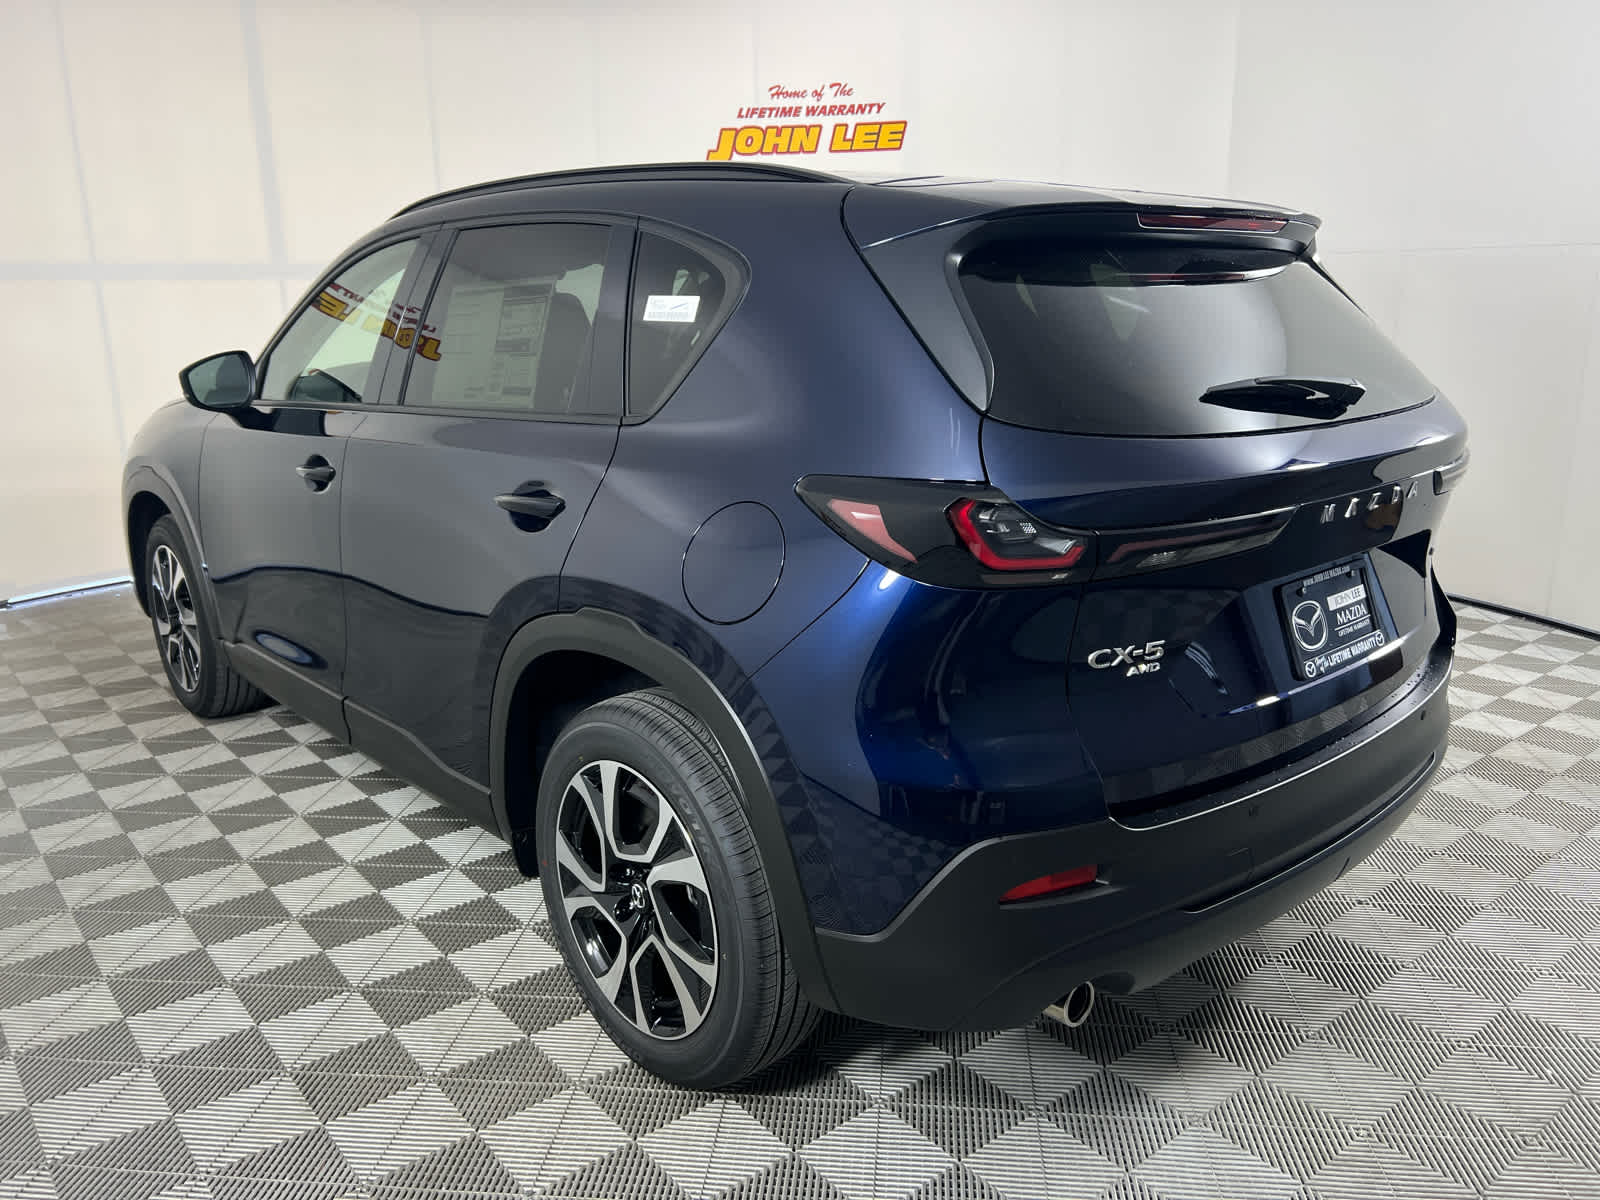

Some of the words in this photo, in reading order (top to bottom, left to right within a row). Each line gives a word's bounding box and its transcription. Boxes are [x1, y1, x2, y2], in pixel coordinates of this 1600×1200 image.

[768, 84, 808, 100] Home
[811, 84, 825, 101] of
[829, 82, 854, 98] The
[737, 105, 802, 119] LIFETIME
[805, 102, 886, 117] WARRANTY
[706, 124, 823, 161] JOHN
[829, 120, 907, 153] LEE
[1320, 480, 1418, 524] MAZDA
[1351, 587, 1363, 600] LEE
[1336, 602, 1368, 625] MAZDA
[1088, 640, 1165, 669] CX-5
[1328, 648, 1352, 667] LIFETIME
[1350, 636, 1376, 657] WARRANTY
[1126, 662, 1161, 677] AWD
